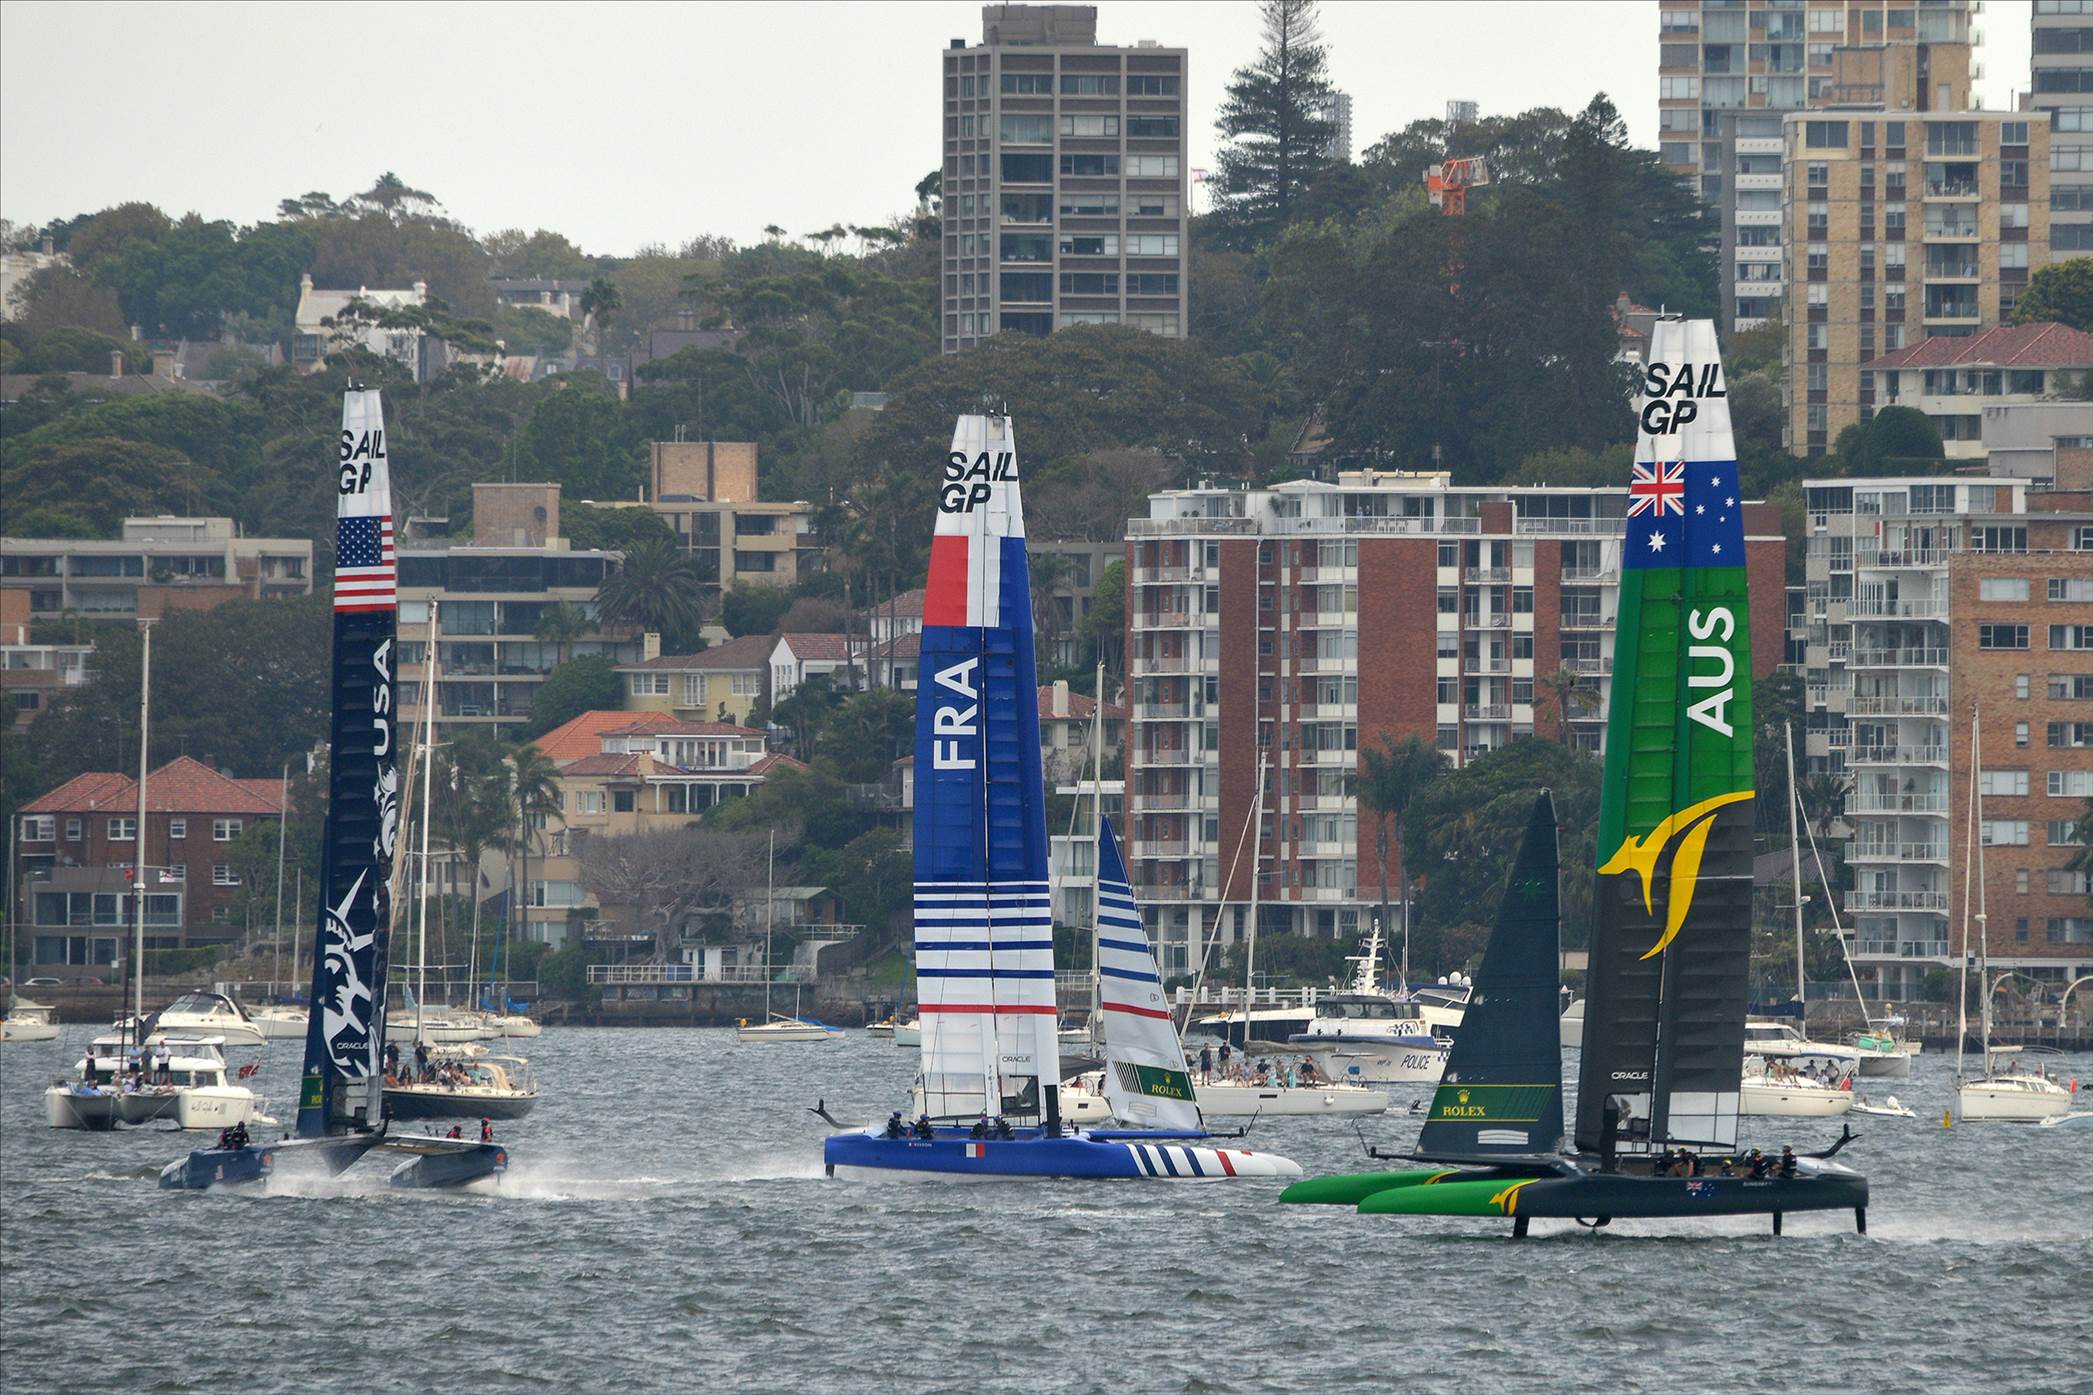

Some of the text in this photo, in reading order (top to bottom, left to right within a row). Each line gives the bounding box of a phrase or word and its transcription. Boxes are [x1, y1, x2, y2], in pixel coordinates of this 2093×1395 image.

[1645, 362, 1727, 399] SAIL
[1641, 399, 1697, 435] GP
[339, 429, 386, 461] SAIL
[338, 463, 372, 495] GP
[944, 452, 1018, 482] SAIL
[939, 483, 992, 513] GP
[1686, 606, 1736, 738] AUS
[373, 638, 391, 757] USA
[933, 657, 979, 771] FRA
[1002, 1055, 1031, 1063] ORACLE
[1401, 1054, 1430, 1070] POLICE
[1151, 1084, 1183, 1097] ROLEX
[1611, 1071, 1649, 1080] ORACLE
[1442, 1105, 1486, 1116] ROLEX
